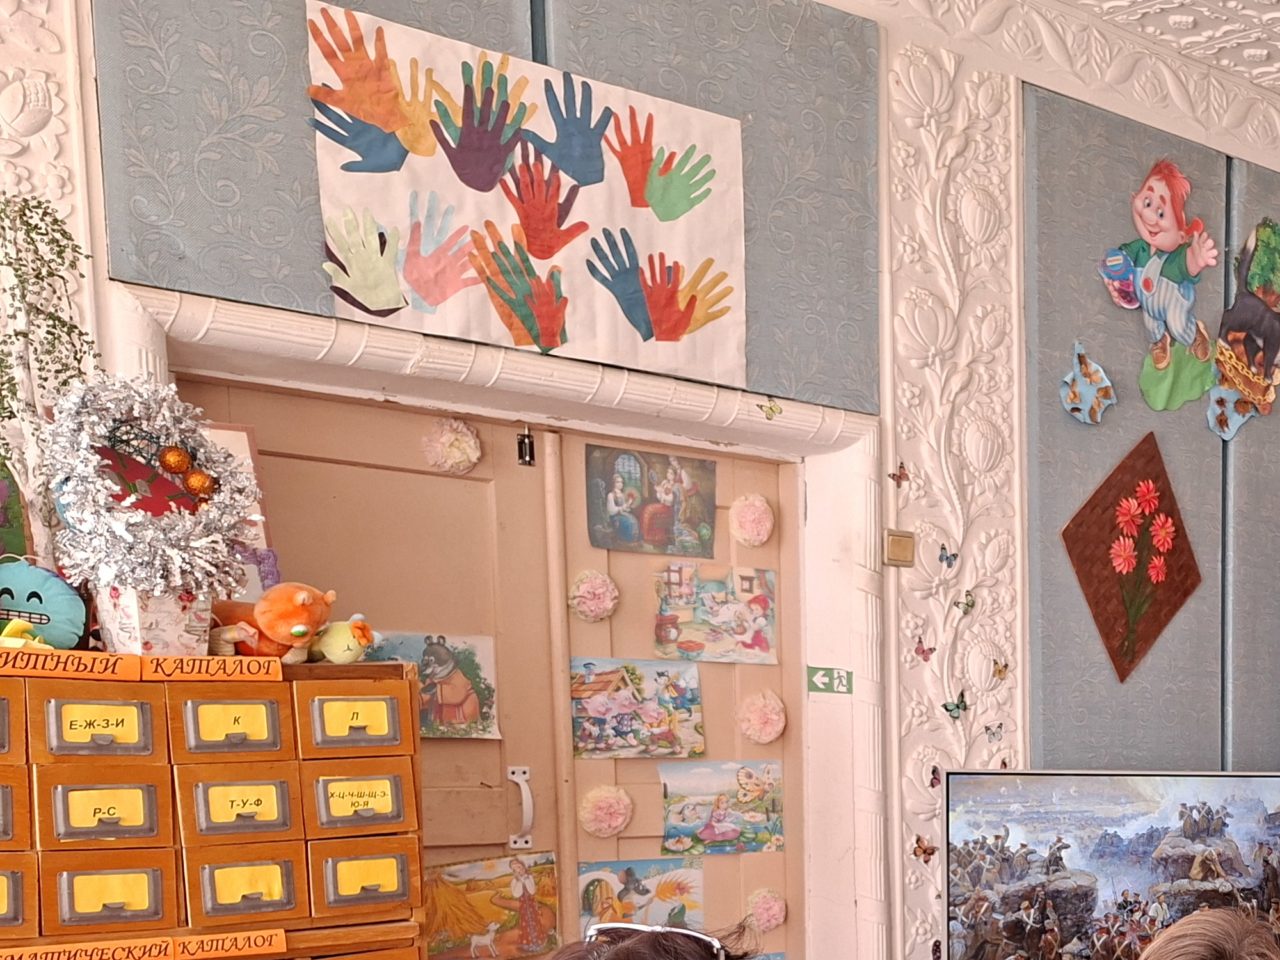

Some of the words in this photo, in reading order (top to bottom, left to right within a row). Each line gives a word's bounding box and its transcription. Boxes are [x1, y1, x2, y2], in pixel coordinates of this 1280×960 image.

[150, 657, 278, 677] КАТАЛОГ
[69, 717, 126, 731] Е-Ж-З-И
[233, 715, 242, 726] К
[229, 797, 263, 810] Т-У-Ф
[350, 800, 369, 808] Ю-Я
[93, 805, 117, 818] Р-С
[178, 933, 278, 956] КАТАЛОГ
